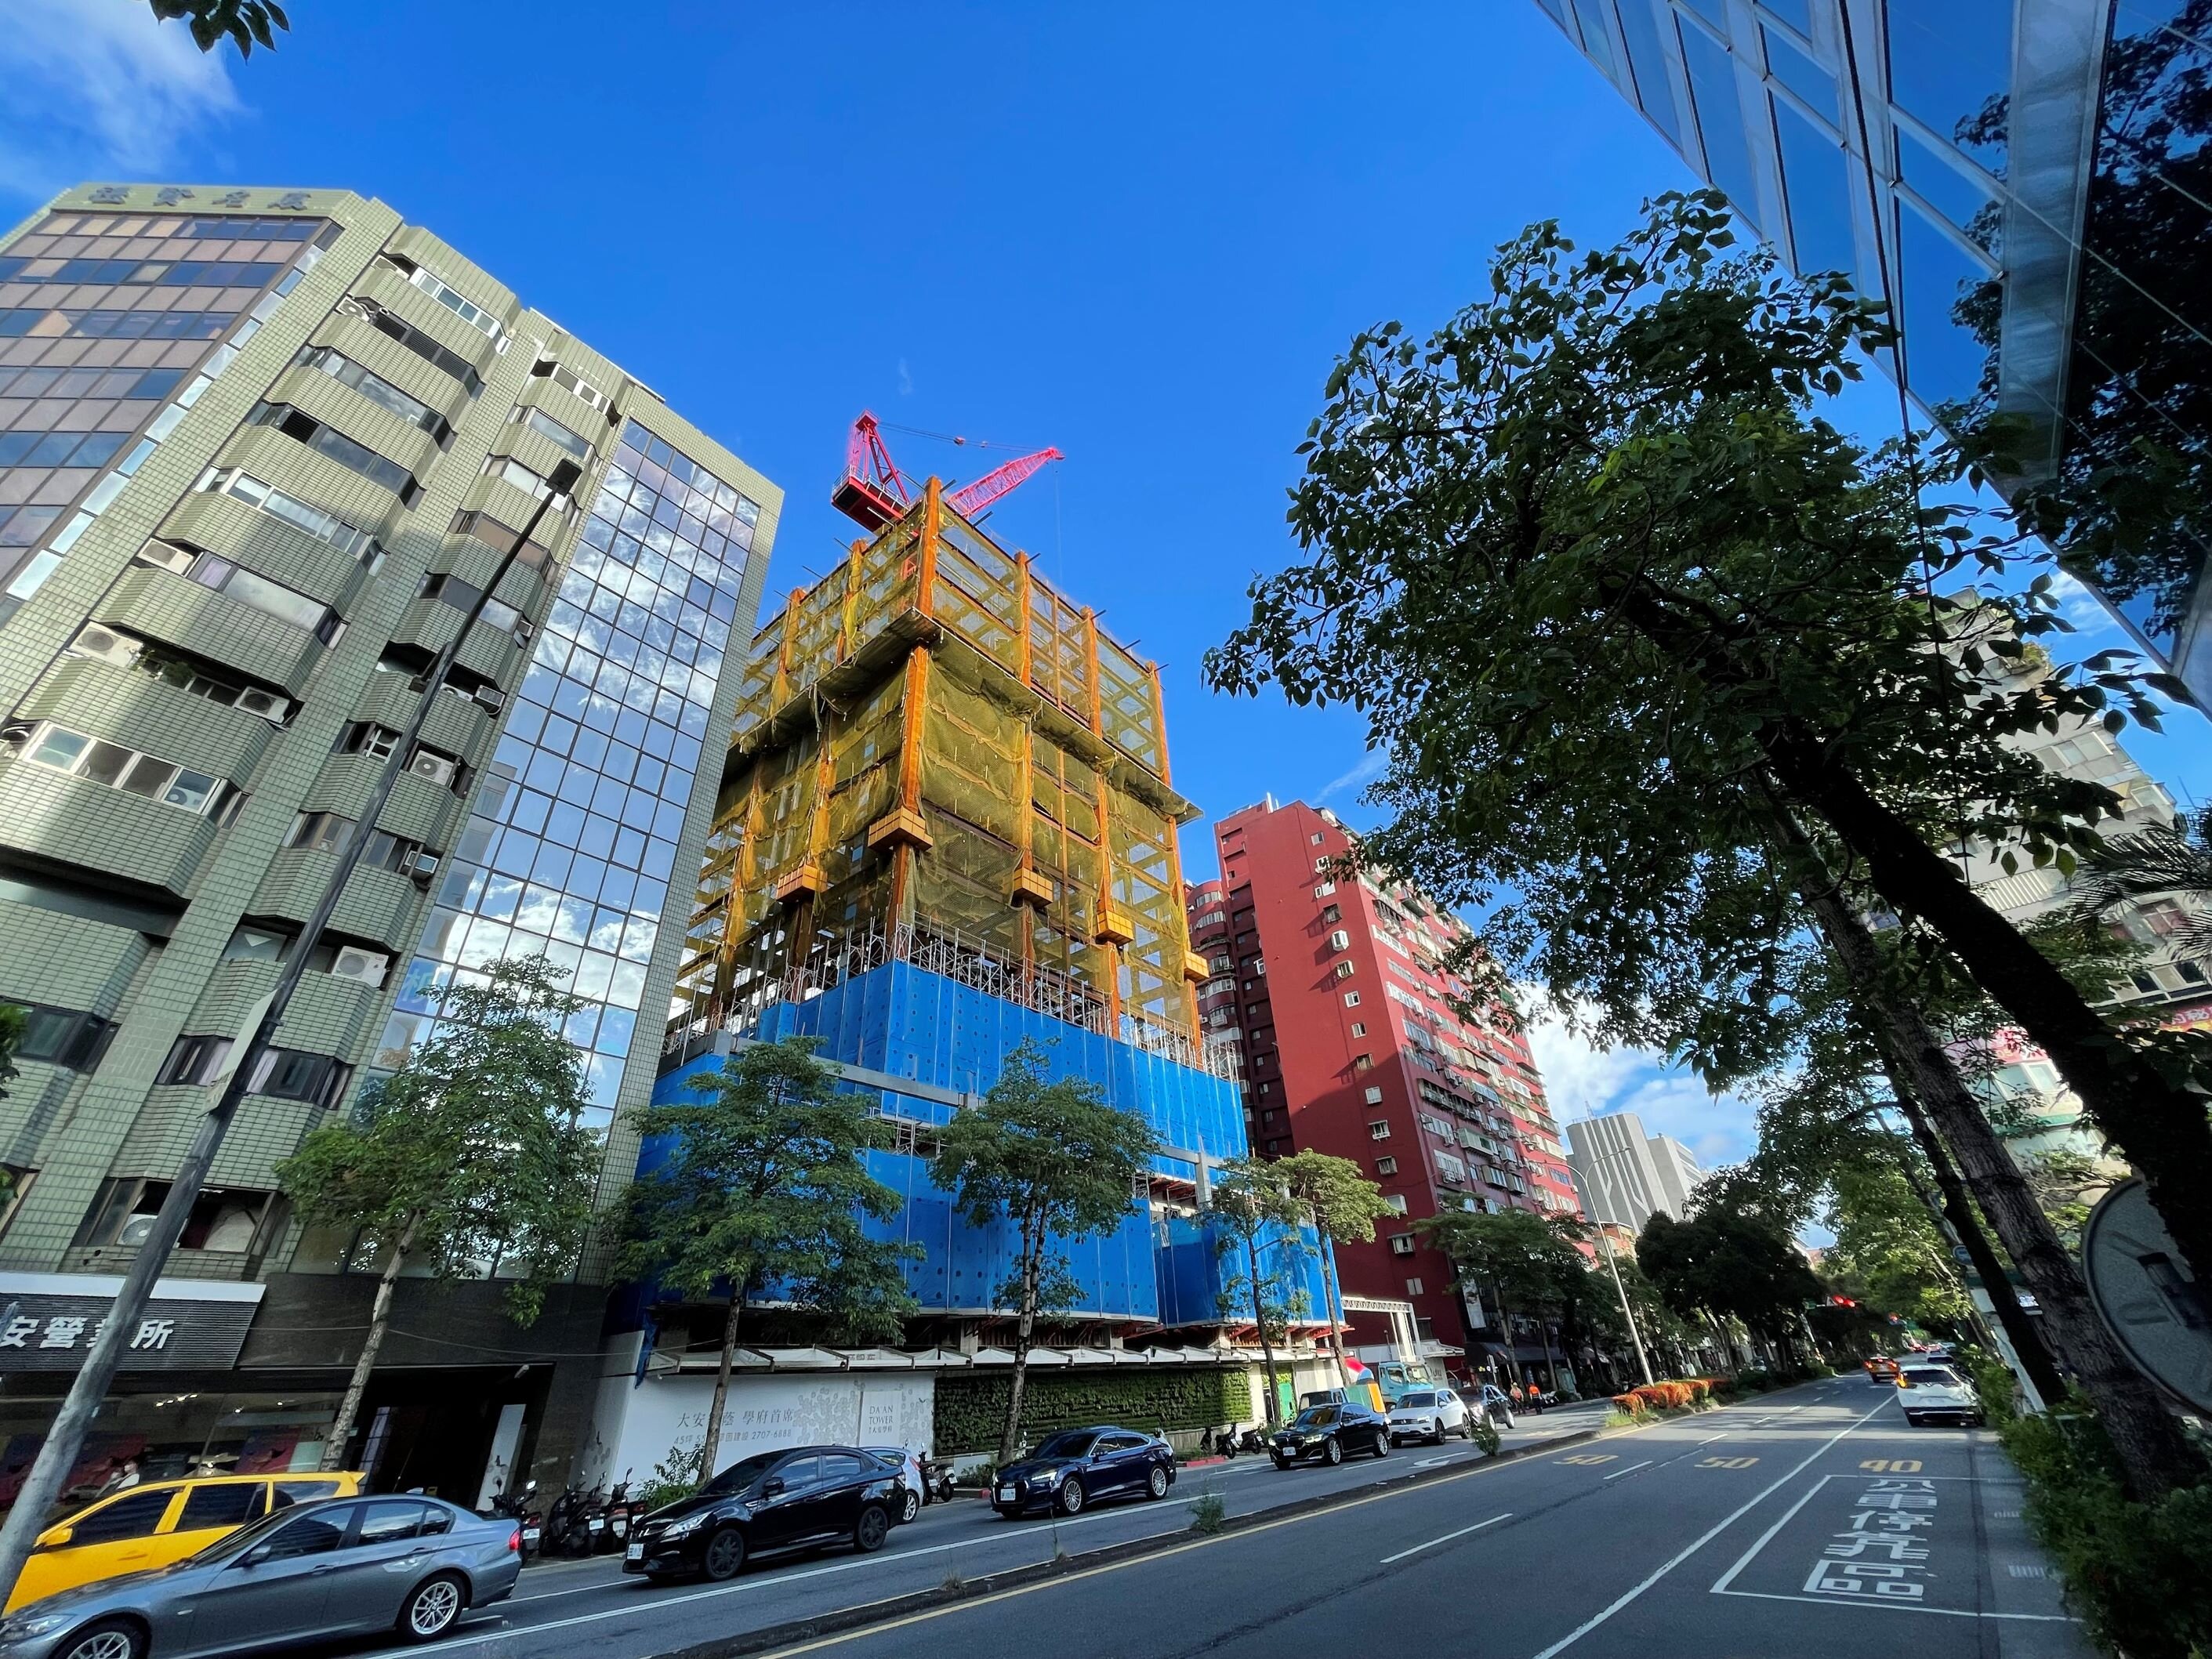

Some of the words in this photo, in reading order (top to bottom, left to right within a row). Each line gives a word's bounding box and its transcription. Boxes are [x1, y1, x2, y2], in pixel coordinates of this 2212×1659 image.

[677, 1411, 734, 1428] 大安蔭
[869, 1416, 894, 1425] TOWER
[752, 1429, 792, 1440] 2707-6888
[1553, 1454, 1619, 1465] 50
[1694, 1456, 1760, 1469] 50
[1858, 1460, 1923, 1472] 40
